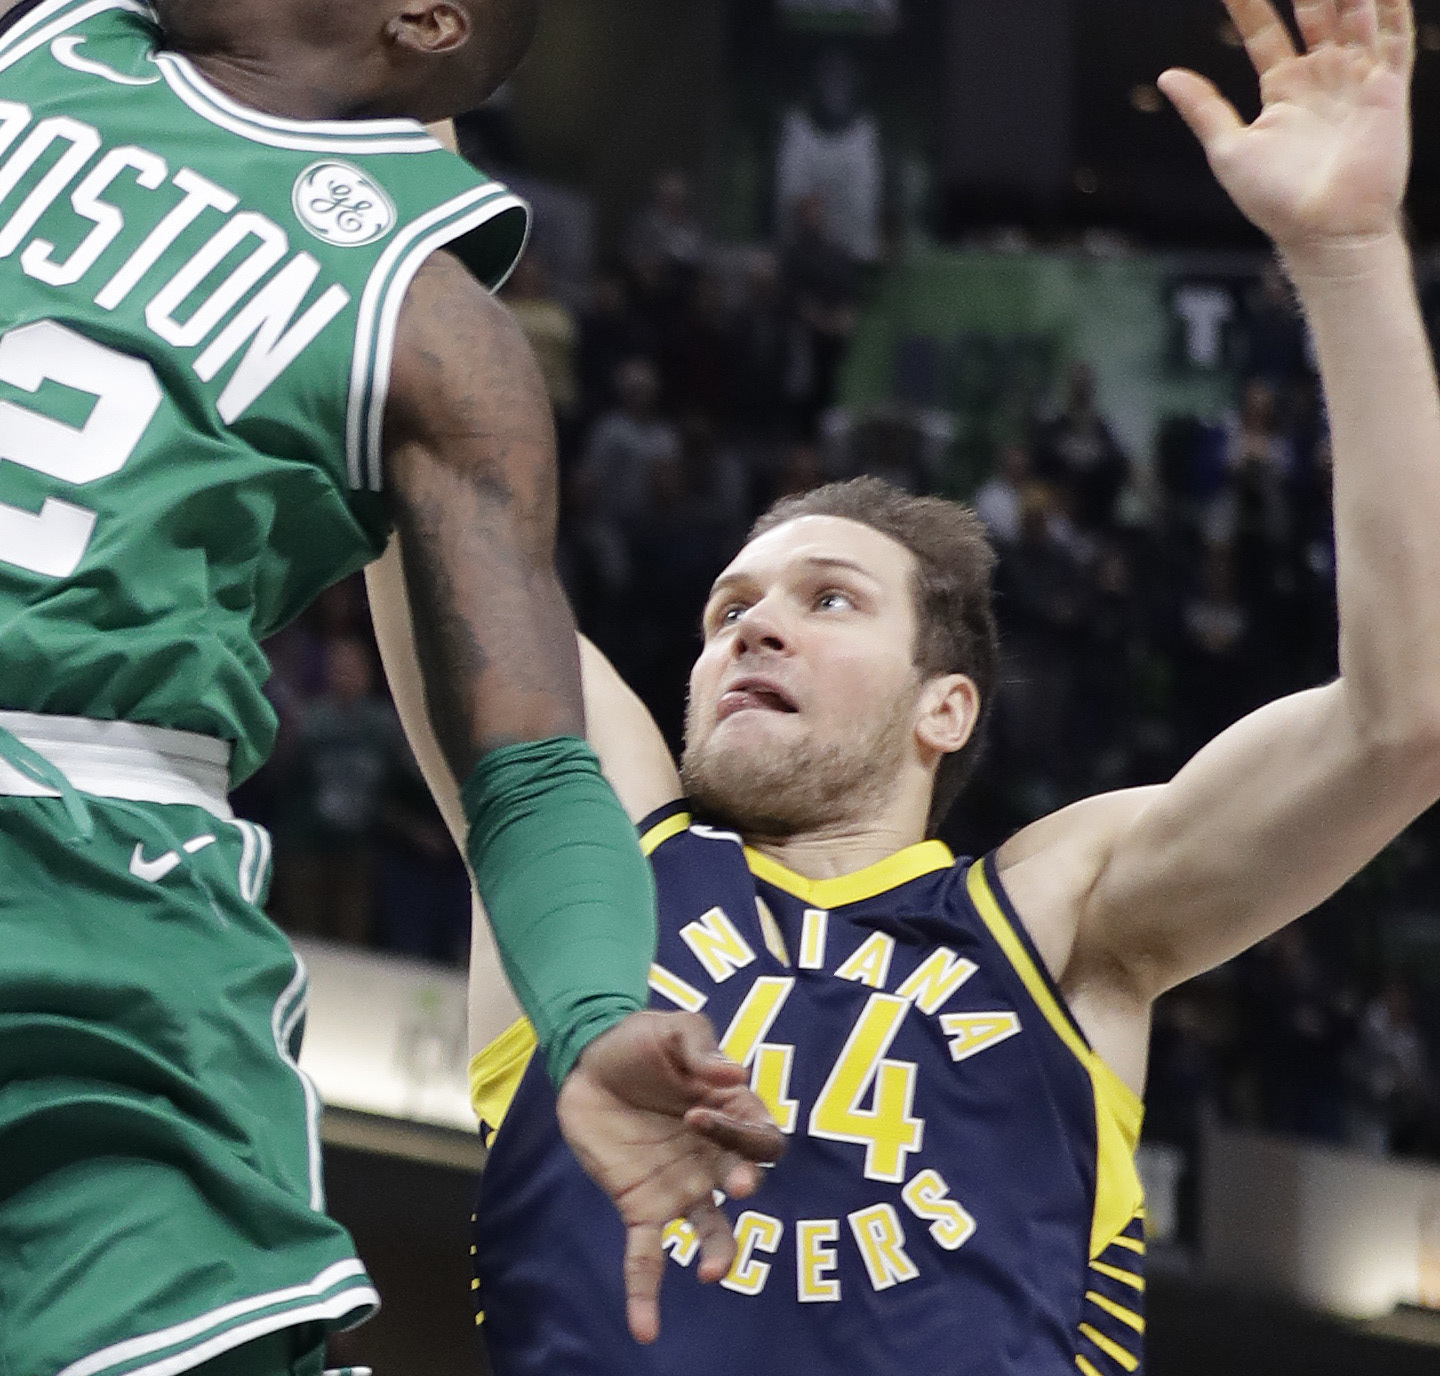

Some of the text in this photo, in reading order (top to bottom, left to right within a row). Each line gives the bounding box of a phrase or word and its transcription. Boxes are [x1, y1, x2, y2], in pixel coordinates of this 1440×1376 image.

[647, 905, 1023, 1061] INIANA
[717, 976, 925, 1184] 44
[661, 1168, 977, 1303] CERS
